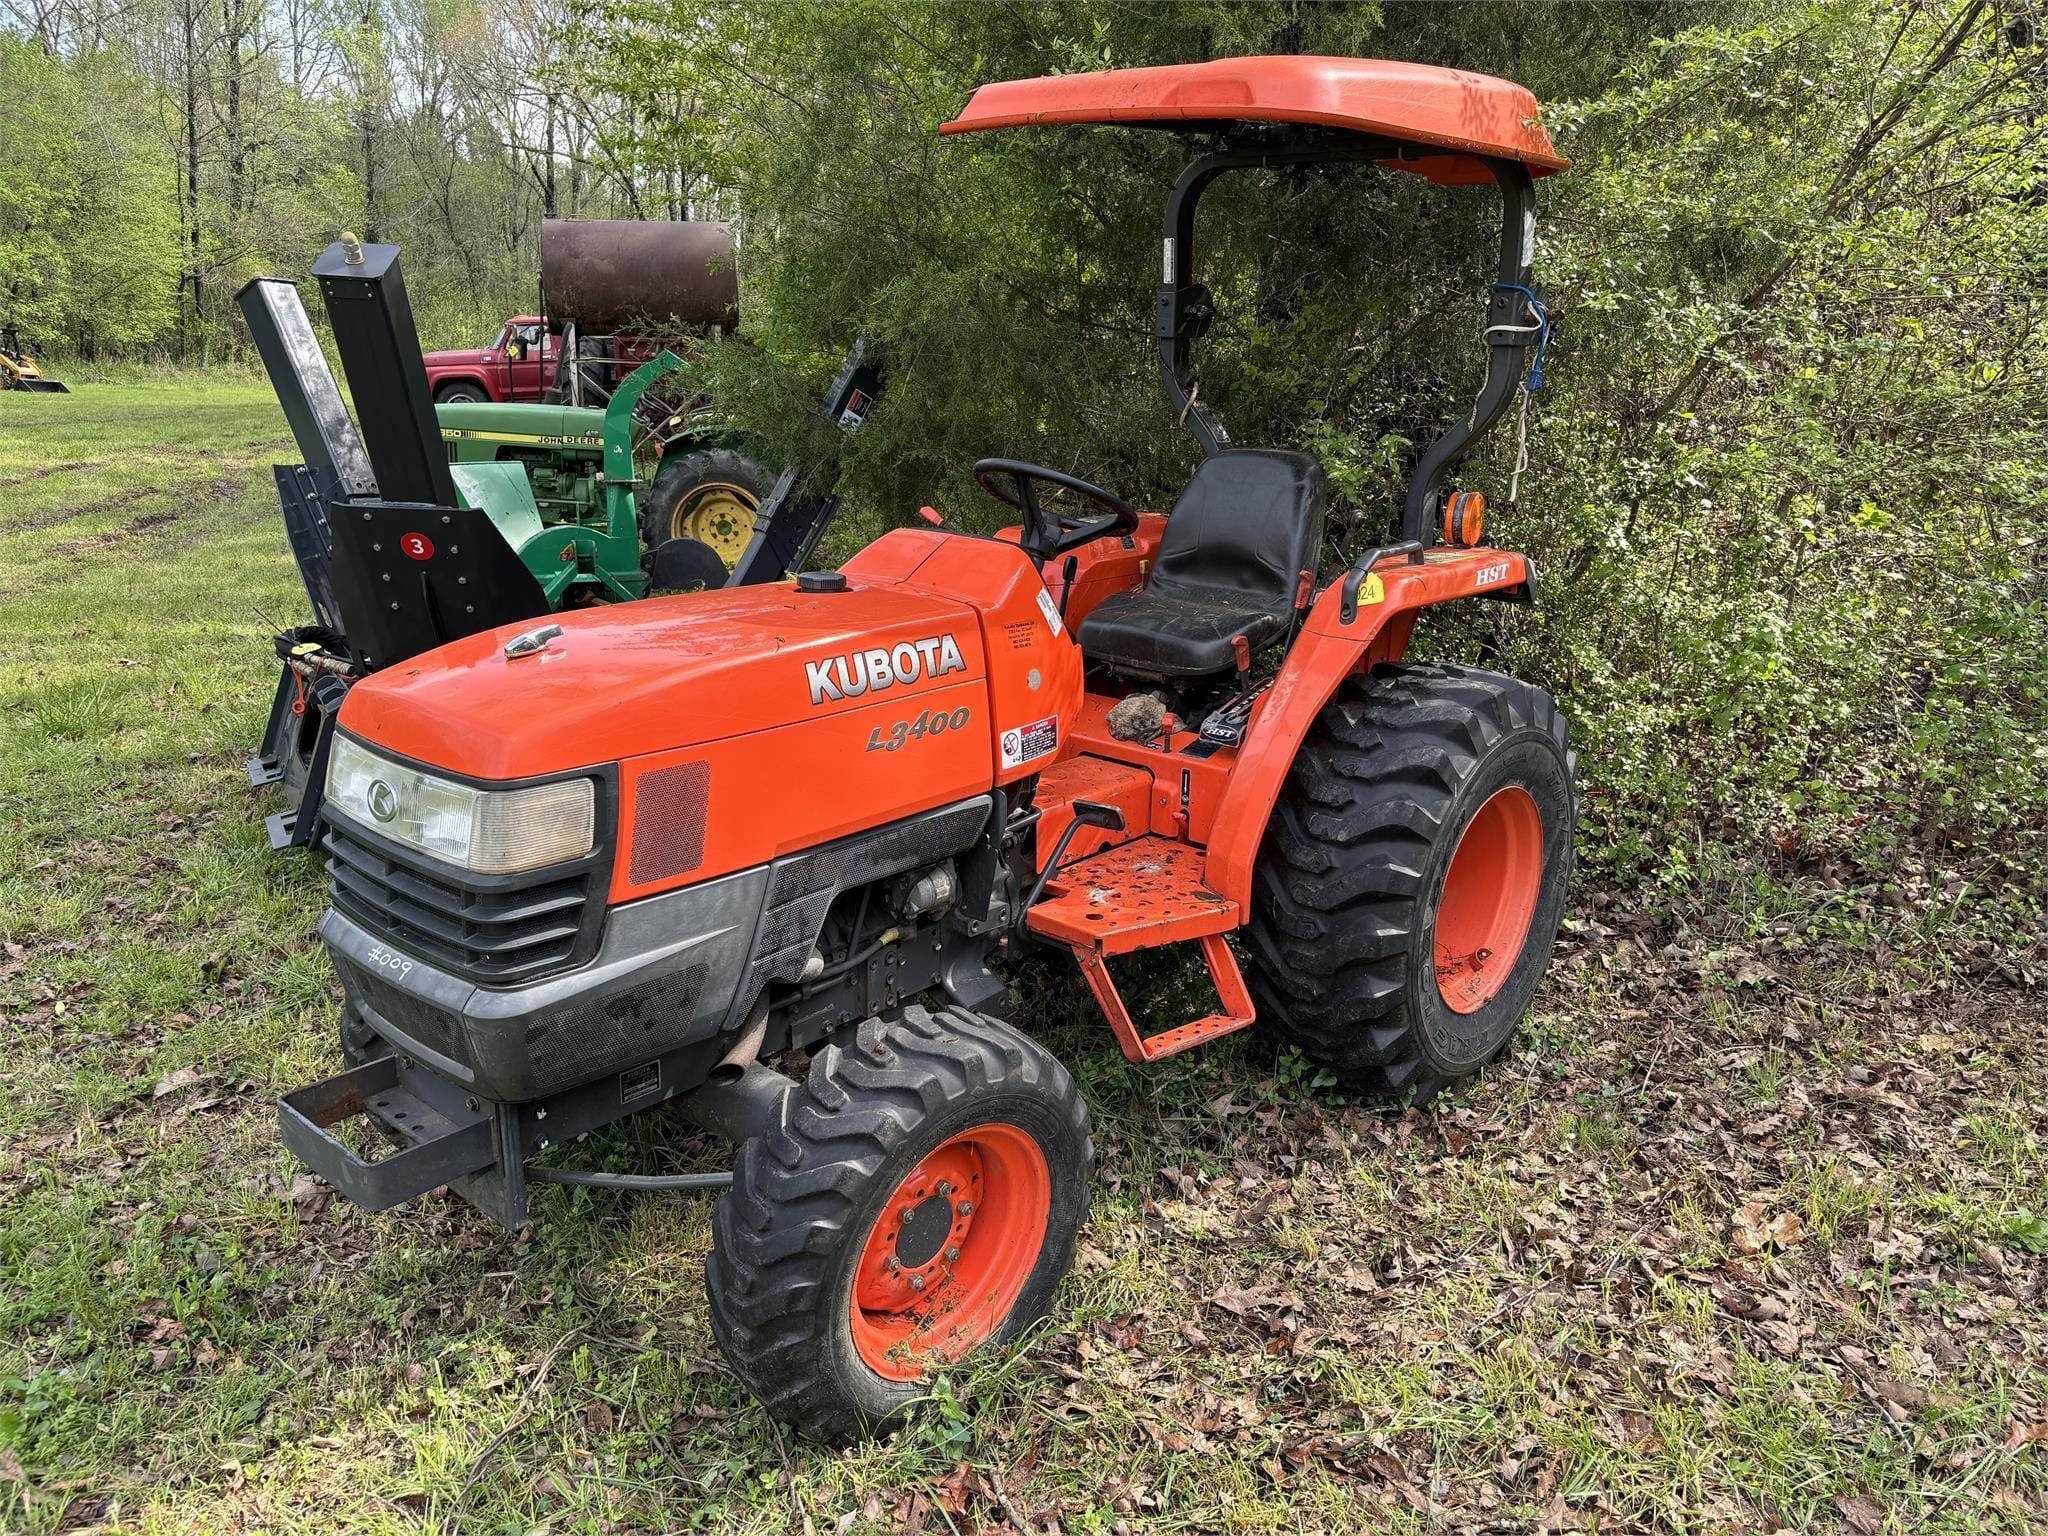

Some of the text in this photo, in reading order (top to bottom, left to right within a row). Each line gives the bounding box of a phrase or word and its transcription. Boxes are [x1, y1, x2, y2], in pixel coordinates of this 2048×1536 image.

[538, 436, 599, 445] JOHN DEERE
[411, 538, 424, 554] 3
[1475, 563, 1509, 587] HST
[805, 633, 967, 705] KUBOTA
[865, 707, 970, 752] L3400
[1547, 767, 1569, 887] TITAN
[368, 945, 413, 980] #009
